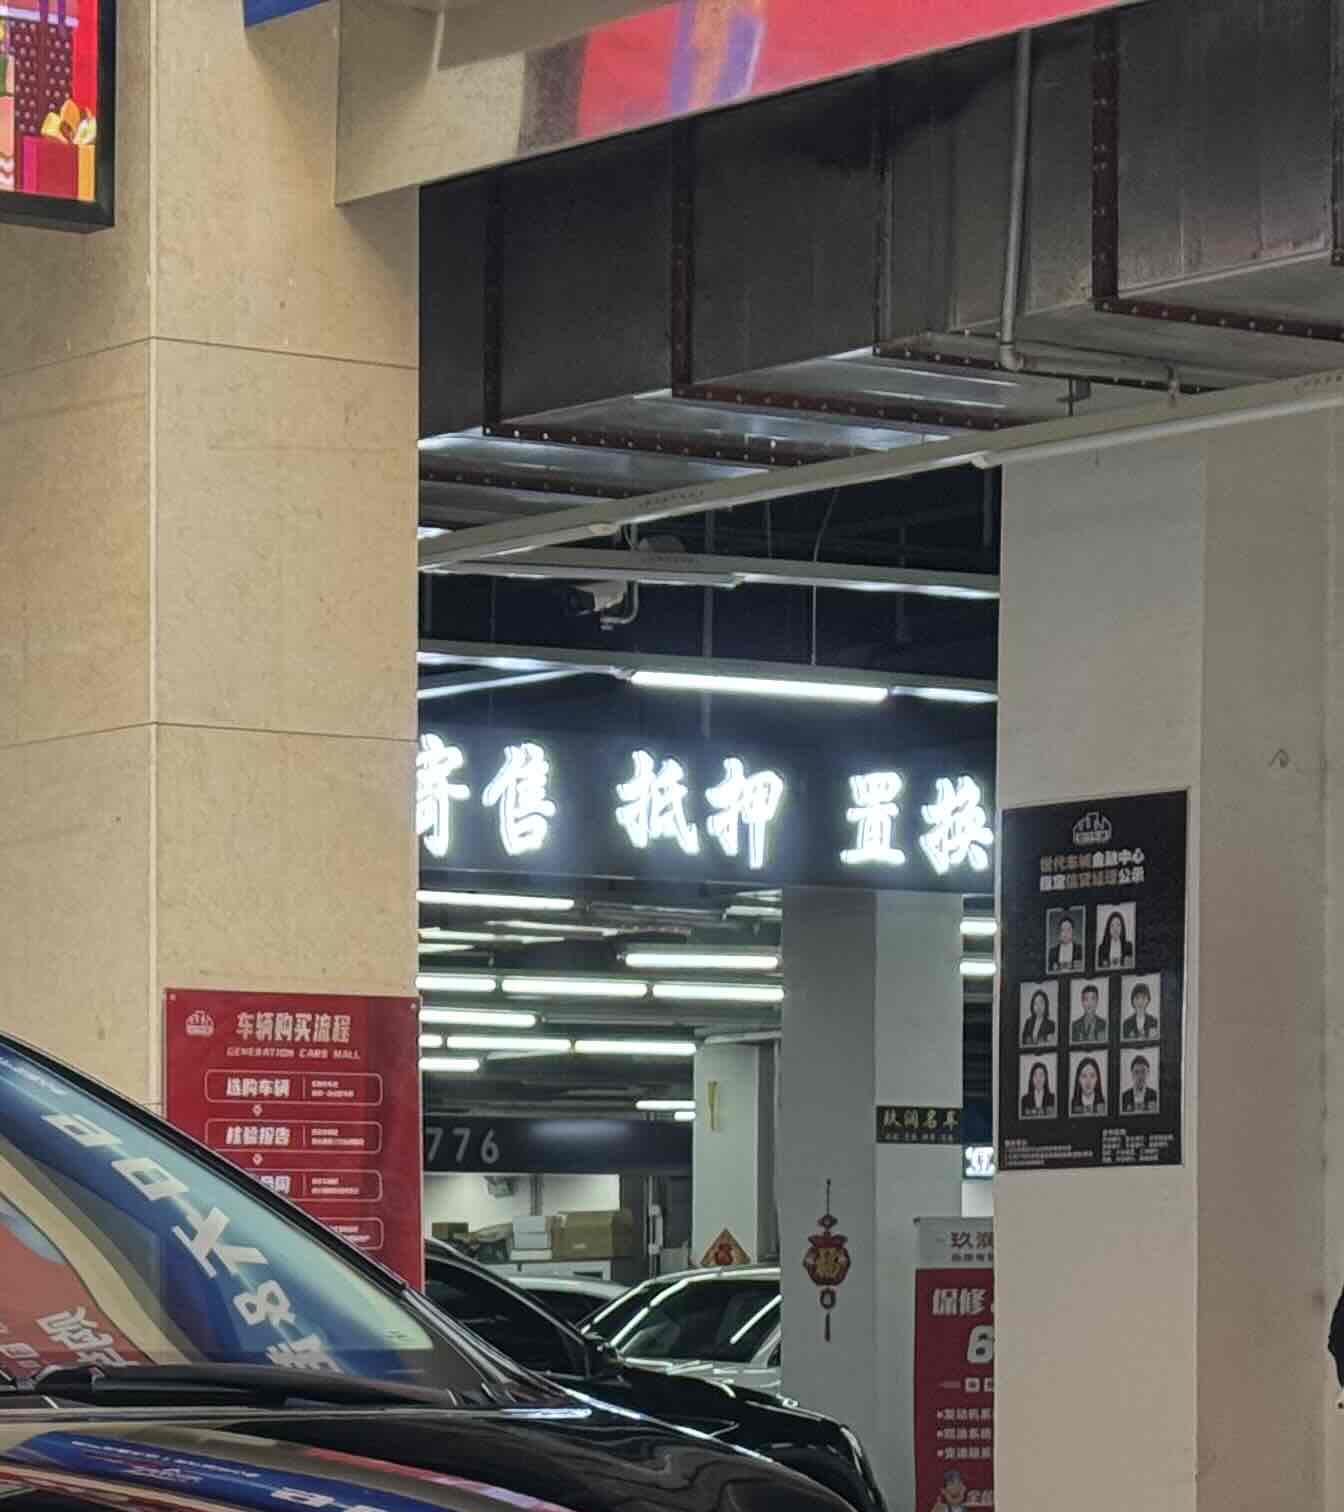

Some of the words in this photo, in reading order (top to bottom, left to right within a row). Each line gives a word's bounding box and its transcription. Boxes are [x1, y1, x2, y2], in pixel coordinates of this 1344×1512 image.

[616, 750, 785, 869] 抵押
[839, 771, 994, 875] 置换
[236, 1012, 351, 1043] 车辆购买流程
[227, 1047, 295, 1057] GENERATION
[298, 1049, 328, 1059] CARS
[333, 1049, 360, 1060] MALL
